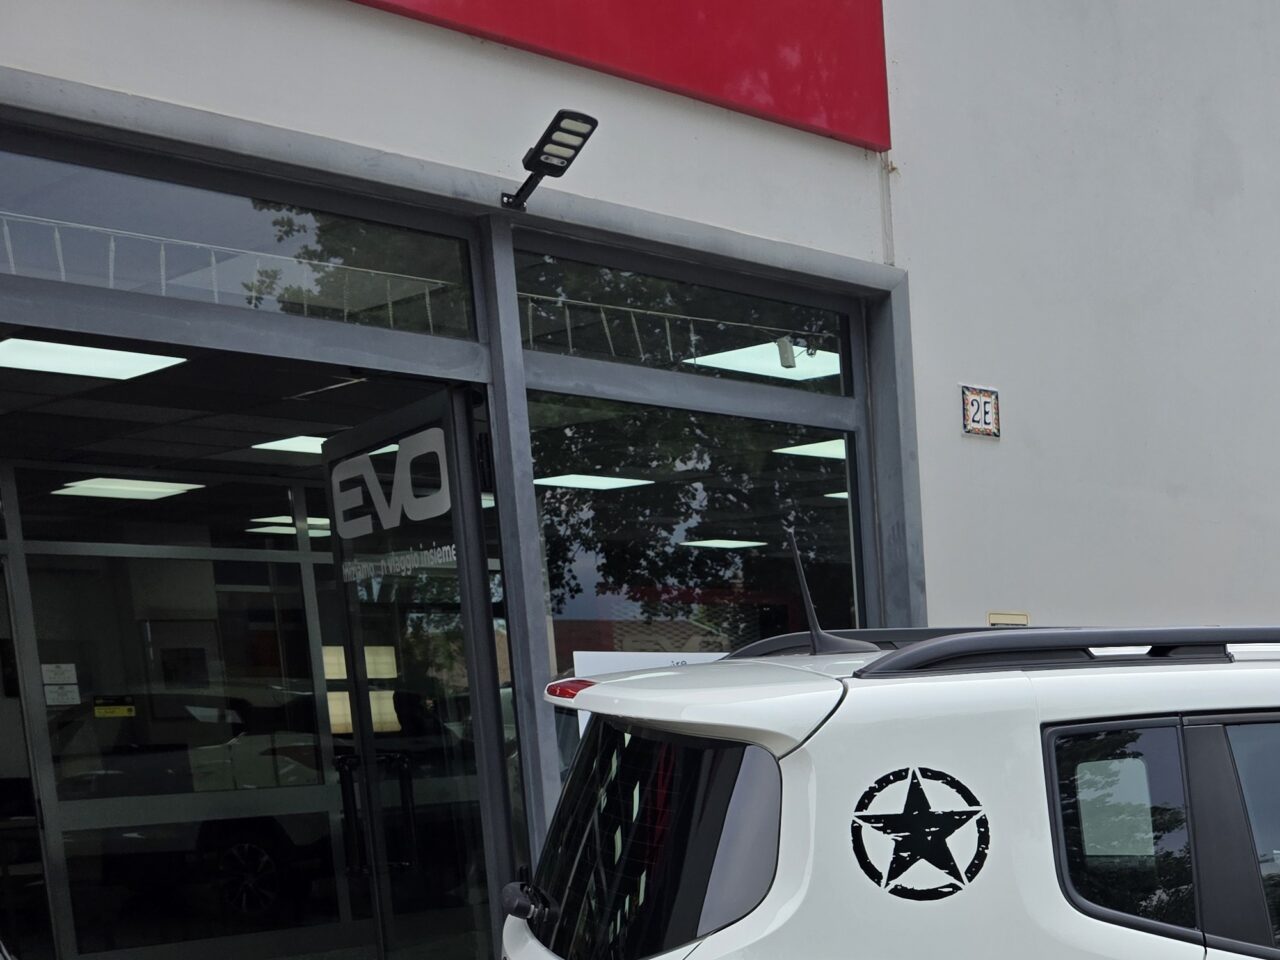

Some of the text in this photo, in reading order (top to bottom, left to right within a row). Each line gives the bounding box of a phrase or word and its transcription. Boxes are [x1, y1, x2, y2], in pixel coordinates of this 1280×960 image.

[970, 398, 992, 426] 2E
[332, 427, 451, 539] EVO
[387, 545, 418, 577] viaggio
[419, 541, 457, 567] insieme
